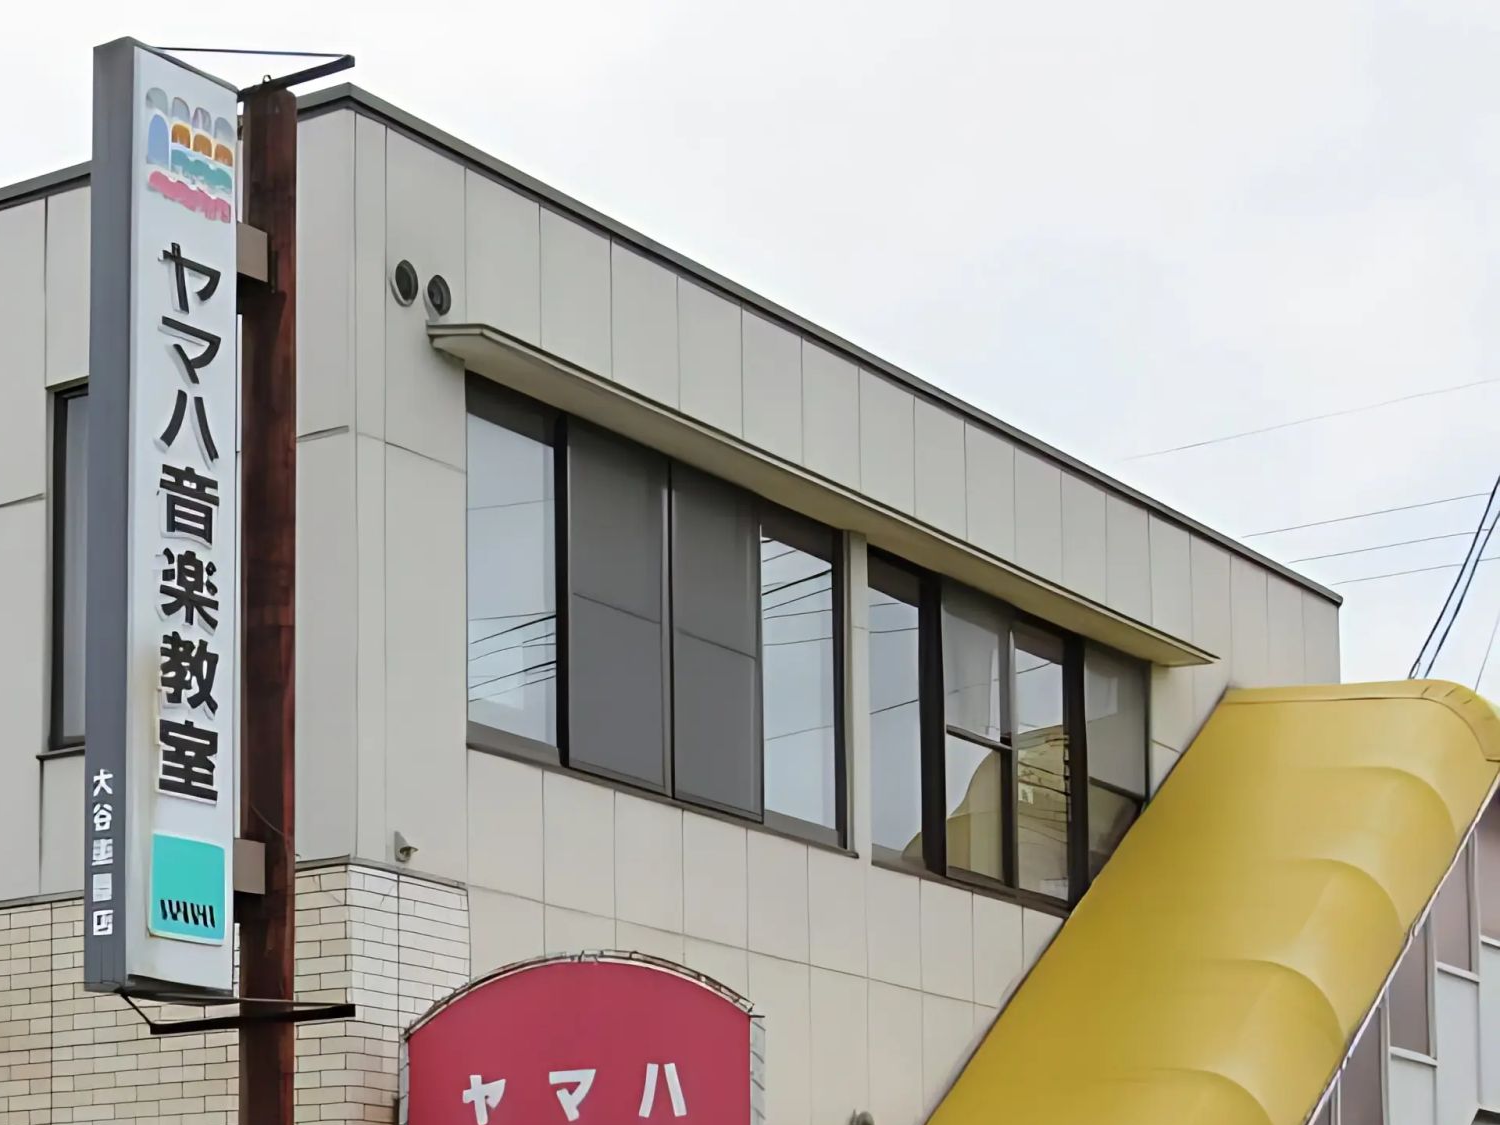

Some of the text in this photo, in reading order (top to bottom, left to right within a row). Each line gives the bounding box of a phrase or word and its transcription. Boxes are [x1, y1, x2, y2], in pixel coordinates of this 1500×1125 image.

[157, 242, 222, 804] ヤマハ音楽教室
